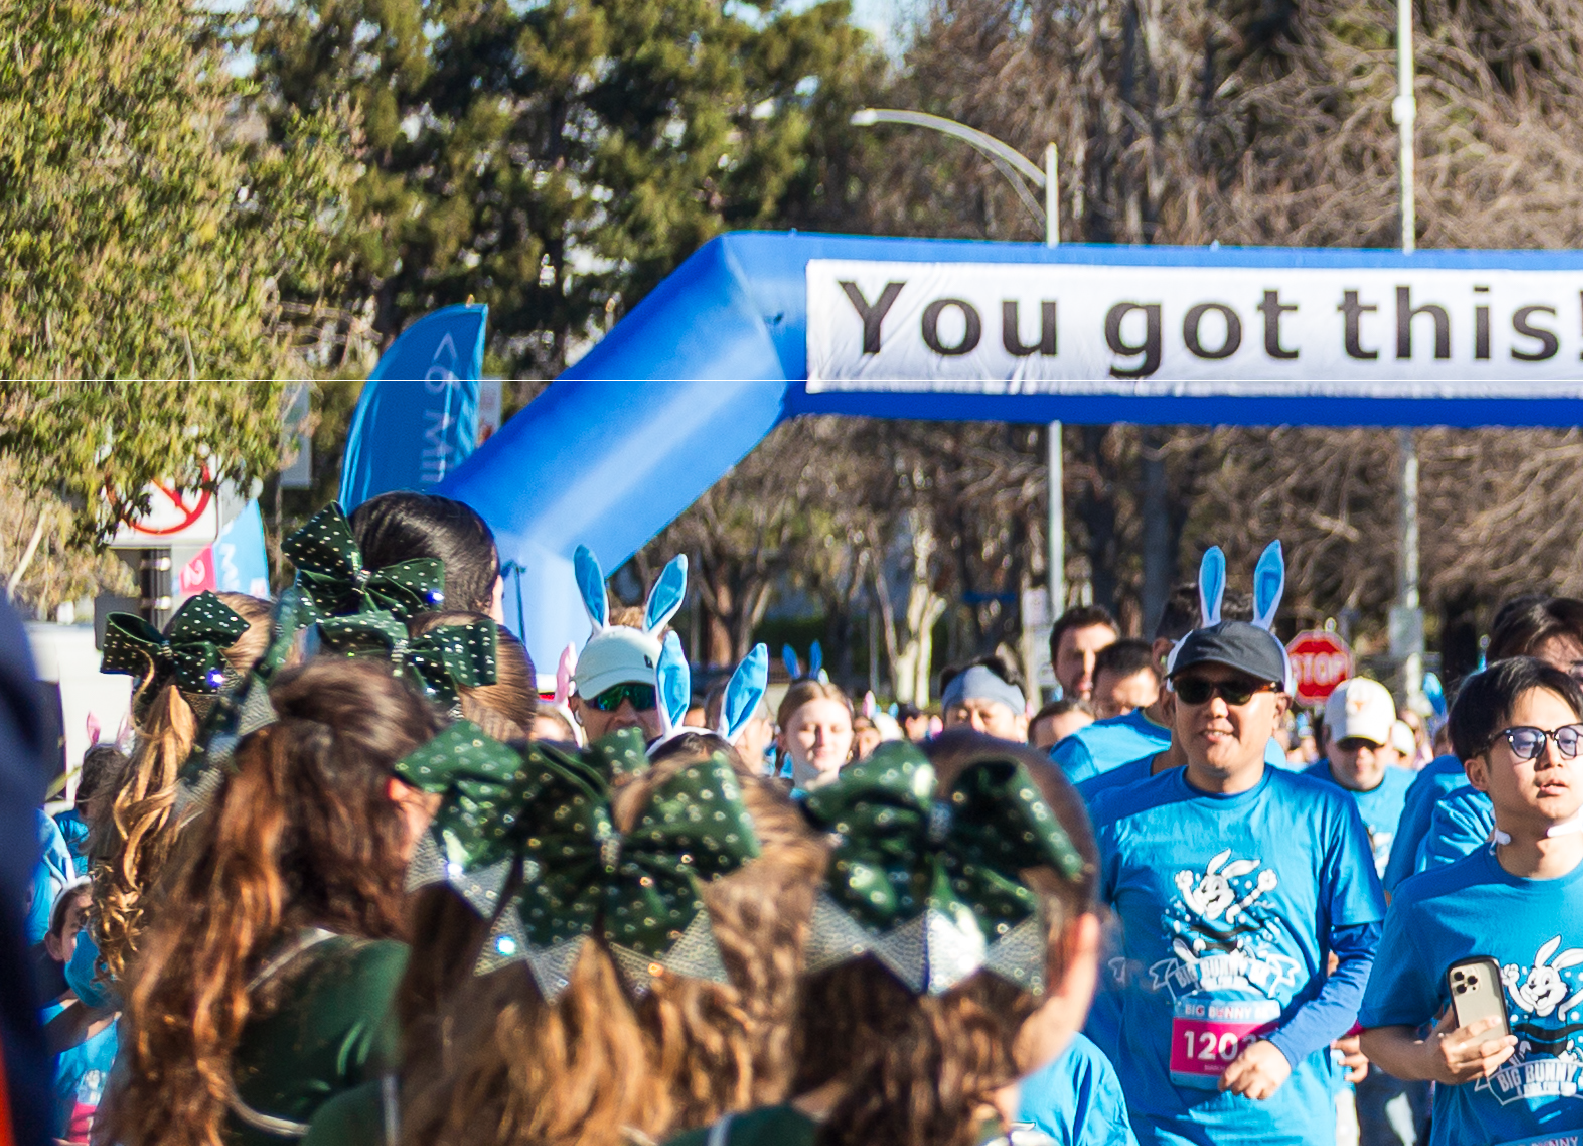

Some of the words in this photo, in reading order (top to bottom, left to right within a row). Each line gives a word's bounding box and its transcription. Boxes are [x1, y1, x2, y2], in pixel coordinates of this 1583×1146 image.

[838, 280, 1058, 357] You
[1104, 289, 1301, 378] got
[1289, 651, 1347, 687] STOP
[1497, 1068, 1521, 1092] BIG
[1525, 1063, 1578, 1082] BUNNY
